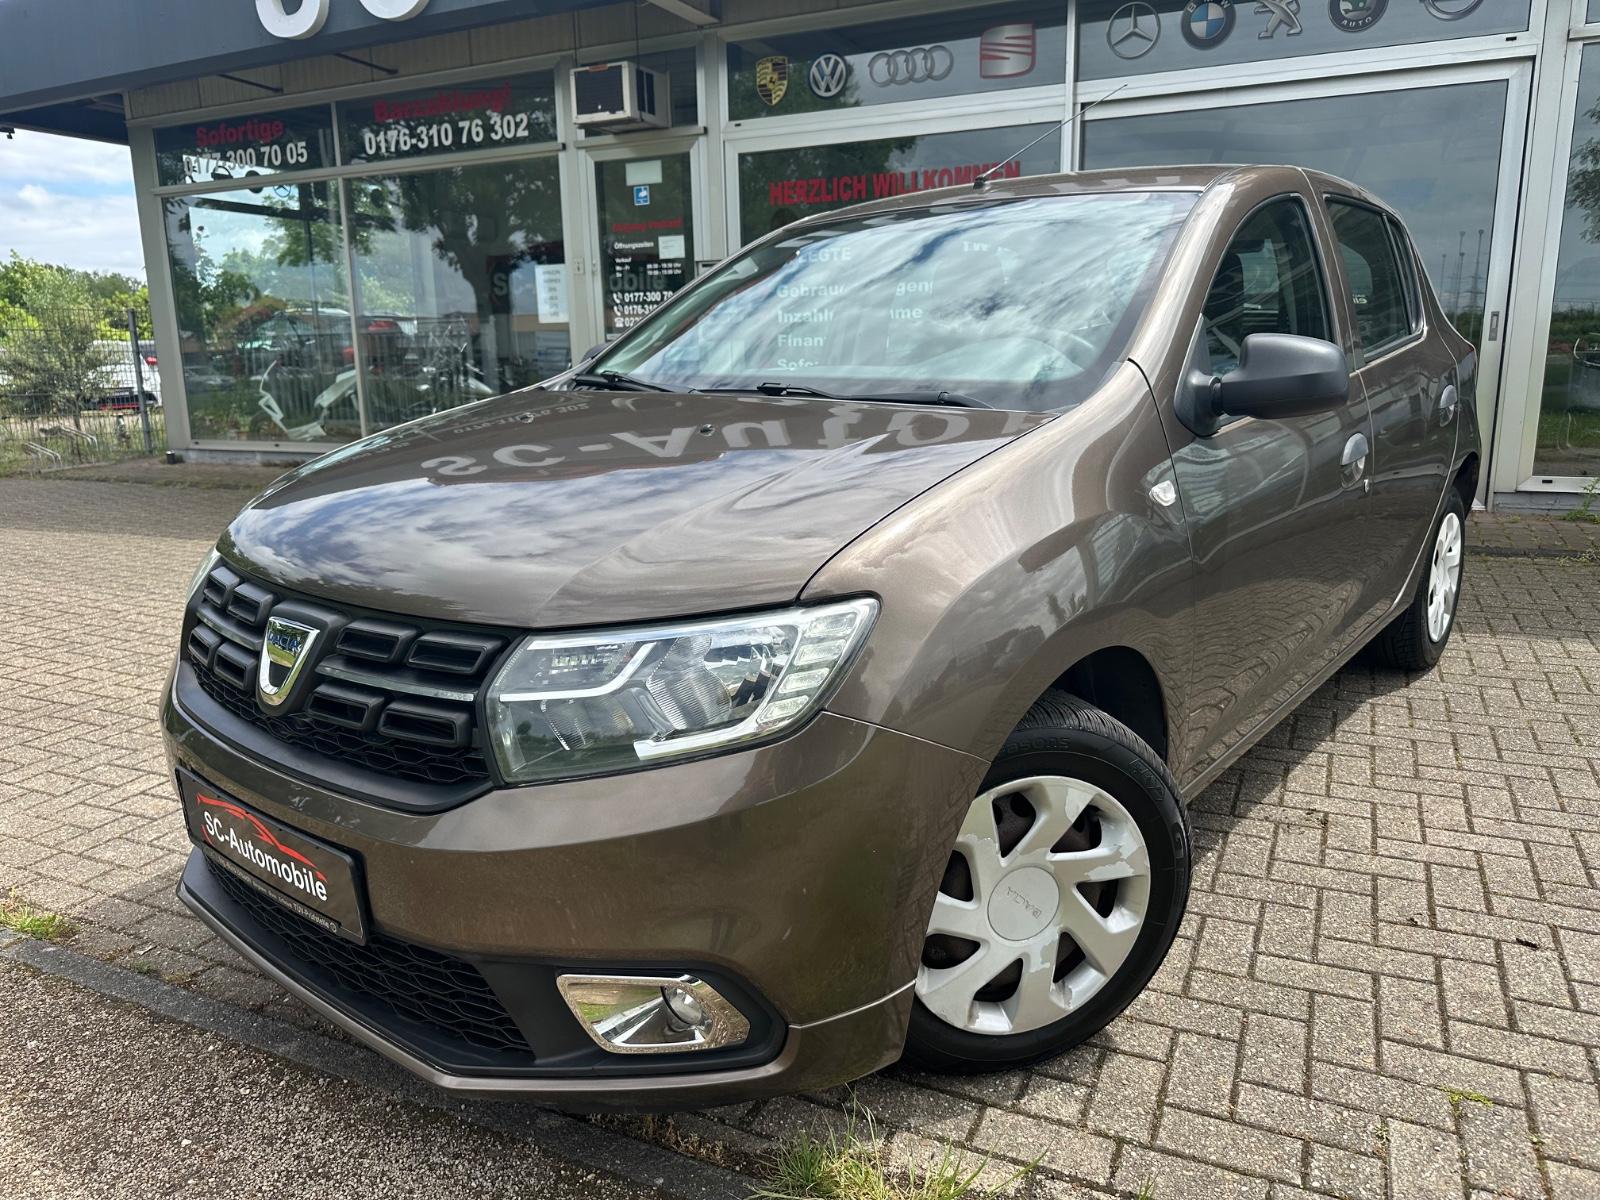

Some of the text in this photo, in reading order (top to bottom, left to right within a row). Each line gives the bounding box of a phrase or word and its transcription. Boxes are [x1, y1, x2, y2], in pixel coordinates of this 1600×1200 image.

[1341, 16, 1373, 28] AUTO
[196, 119, 285, 148] Sofortige
[364, 113, 529, 155] 0176-310 76 302
[260, 144, 283, 167] 70
[286, 141, 308, 165] 05
[769, 174, 866, 206] HERZLICH
[624, 292, 661, 302] 0177-300
[203, 811, 328, 902] SC-Automobile
